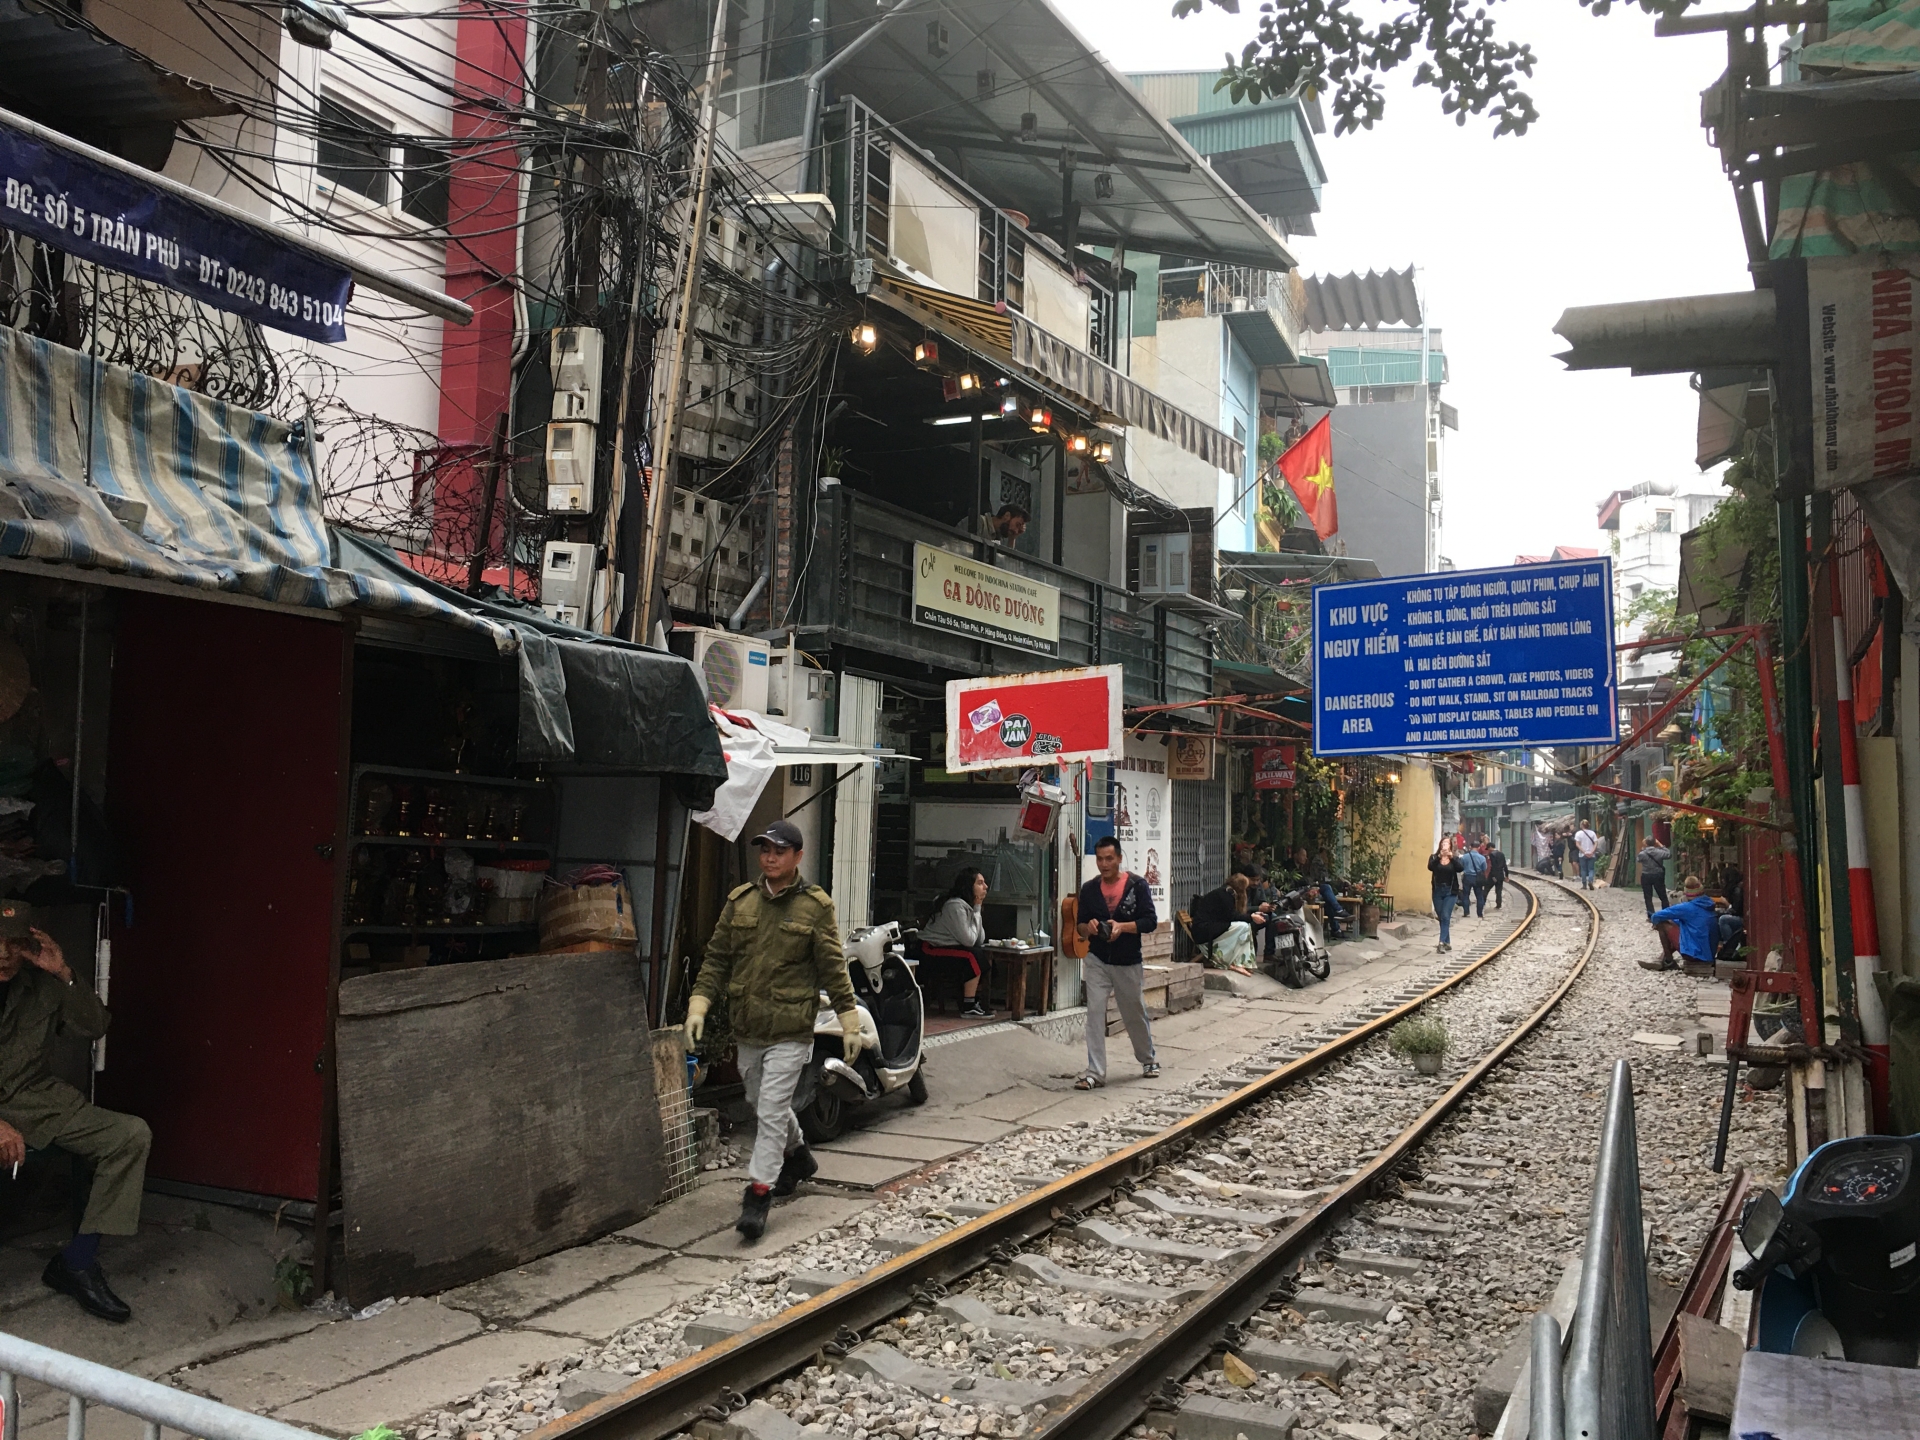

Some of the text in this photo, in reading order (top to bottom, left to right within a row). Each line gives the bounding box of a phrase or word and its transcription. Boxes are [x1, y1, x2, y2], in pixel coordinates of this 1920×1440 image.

[6, 177, 37, 218] ĐC:
[44, 191, 68, 230] SỐ
[74, 206, 84, 236] 5
[91, 213, 140, 257] TRẦN
[146, 232, 179, 270] PHÚ
[199, 254, 223, 288] ĐT:
[226, 270, 265, 305] 0243
[269, 287, 298, 317] 843
[303, 295, 343, 326] 5104
[1872, 268, 1912, 340] NHA
[1822, 304, 1839, 471] Website: www.nhakhoamy.com
[1873, 348, 1912, 434] KHOA
[954, 565, 976, 579] WELCOME
[978, 572, 984, 580] TO
[985, 574, 1008, 589] INDOCHINA
[1009, 583, 1026, 594] STATION
[1407, 568, 1599, 603] KHÔNG TỤ TẬP ĐÔNG NGƯỜI, QUAY PHIM, CHỤP ẢNH
[943, 579, 1045, 626] GA ĐÔNG DƯƠNG
[1330, 602, 1388, 626] KHU VỰC
[1408, 609, 1432, 625] KHÔNG
[1434, 609, 1444, 624] ĐI,
[1446, 604, 1469, 622] ĐỨNG,
[1491, 602, 1510, 618] TRÊN
[1513, 599, 1539, 616] ĐƯỜNG
[1542, 598, 1556, 614] SẮT
[1324, 628, 1399, 658] NGUY HIỂM
[1408, 631, 1433, 647] KHÔNG
[1435, 630, 1445, 645] KÊ
[1447, 629, 1462, 644] BÀN
[1464, 624, 1481, 643] GHẾ,
[1500, 626, 1516, 640] BÁN
[1518, 622, 1540, 638] HÀNG
[1542, 623, 1568, 636] TRONG
[1570, 618, 1592, 634] LÒNG
[1404, 649, 1491, 672] VÀ HAI BÊN ĐƯỜNG SẮT
[1410, 679, 1420, 690] DO
[1421, 678, 1435, 689] NOT
[1438, 676, 1466, 688] GATHER
[1468, 676, 1473, 686] A
[1475, 674, 1506, 688] CROWD,
[1530, 670, 1563, 684] PHOTOS,
[1565, 668, 1594, 680] VIDEOS
[1325, 692, 1395, 711] DANGEROUS
[1410, 686, 1593, 707] DO NOT WALK, STAND, SIT ON RAILROAD TRACKS
[1342, 717, 1373, 733] AREA
[1409, 704, 1599, 724] DO NOT DISPLAY CHAIRS, TABLES AND PEDDLE ON
[1003, 731, 1026, 742] JAM
[1406, 726, 1519, 742] AND ALONG RAILROAD TRACKS
[794, 766, 810, 781] 116
[1255, 770, 1294, 781] RAILWAY
